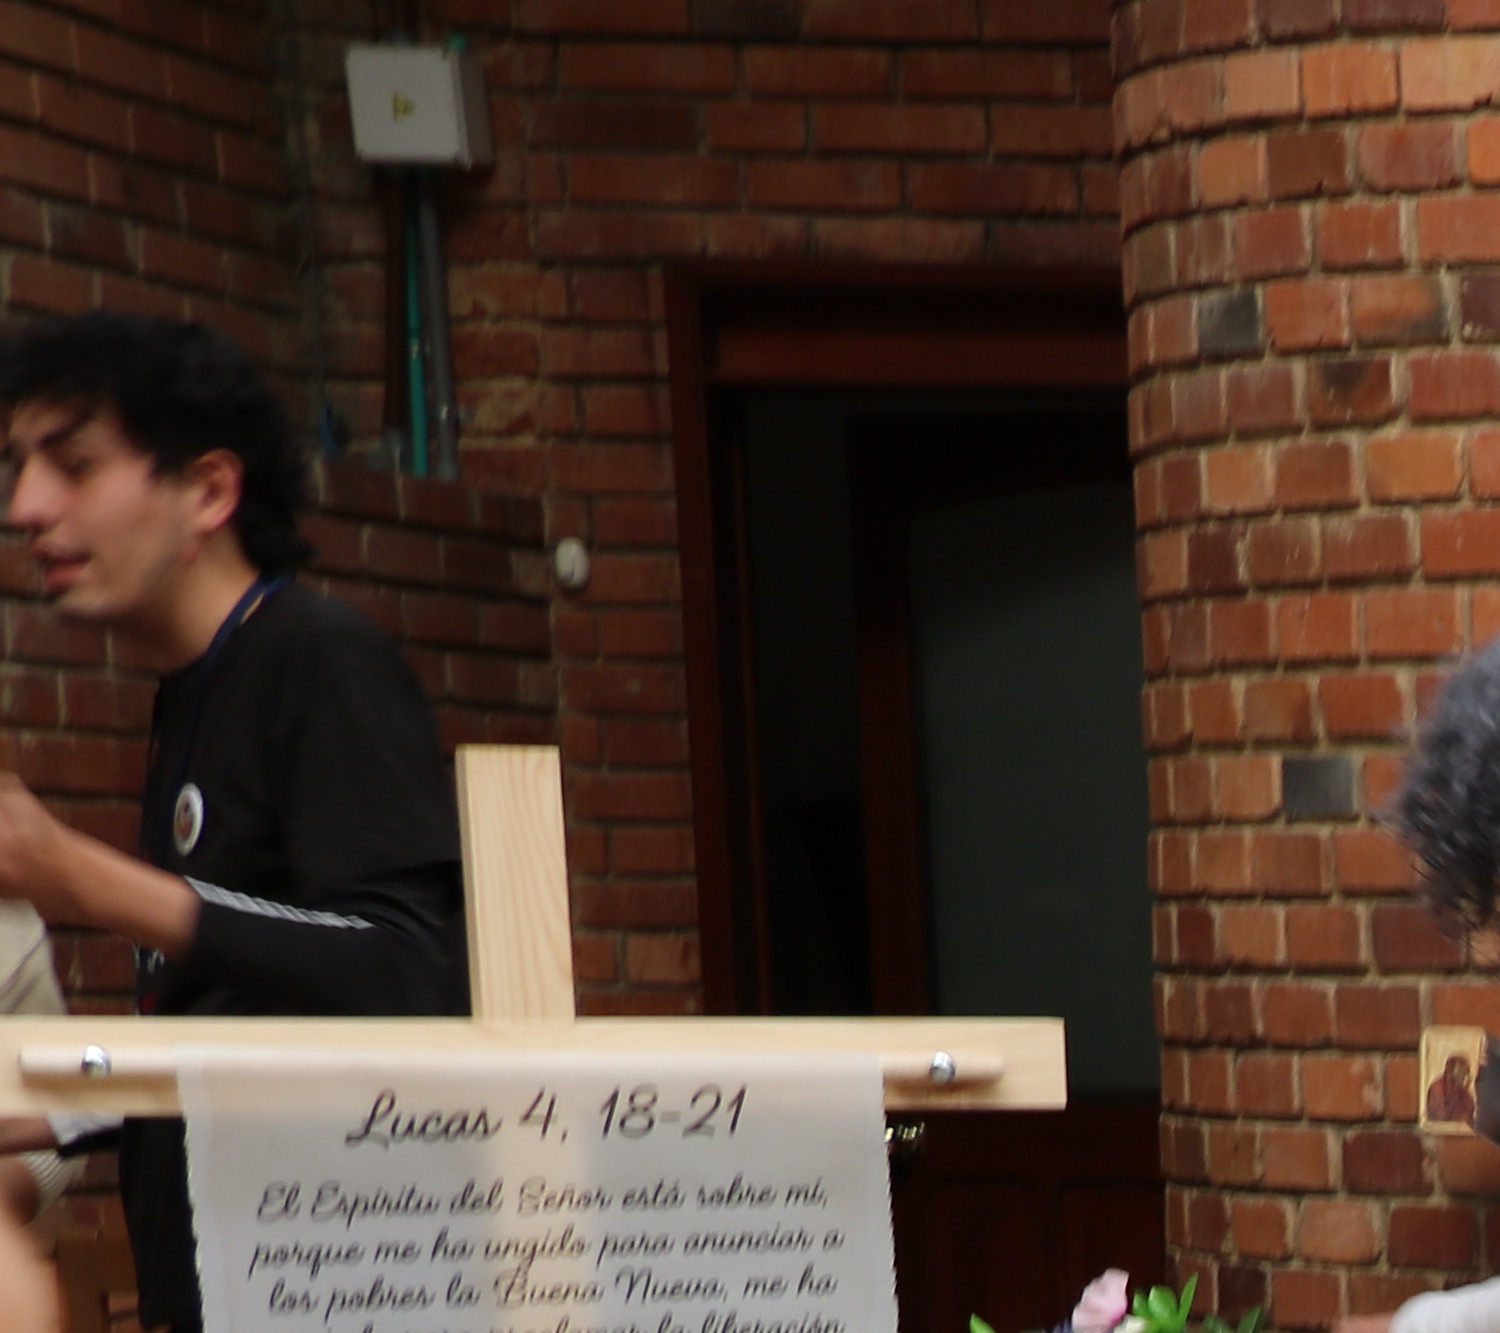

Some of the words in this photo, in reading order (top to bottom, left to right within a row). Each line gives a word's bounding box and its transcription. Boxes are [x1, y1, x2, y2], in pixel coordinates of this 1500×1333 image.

[344, 1087, 502, 1151] Lucas
[519, 1086, 569, 1144] 4,
[599, 1084, 748, 1141] 18-21
[257, 1182, 301, 1223] El
[310, 1180, 440, 1231] Espíritu
[450, 1176, 503, 1214] del
[517, 1175, 611, 1216] Señor
[697, 1172, 779, 1209] sobre
[247, 1240, 365, 1281] porque
[374, 1241, 422, 1266] me
[431, 1226, 476, 1264] ha
[484, 1226, 593, 1275] ungido
[596, 1233, 675, 1279] para
[684, 1229, 814, 1255] anunciar
[822, 1231, 846, 1252] a
